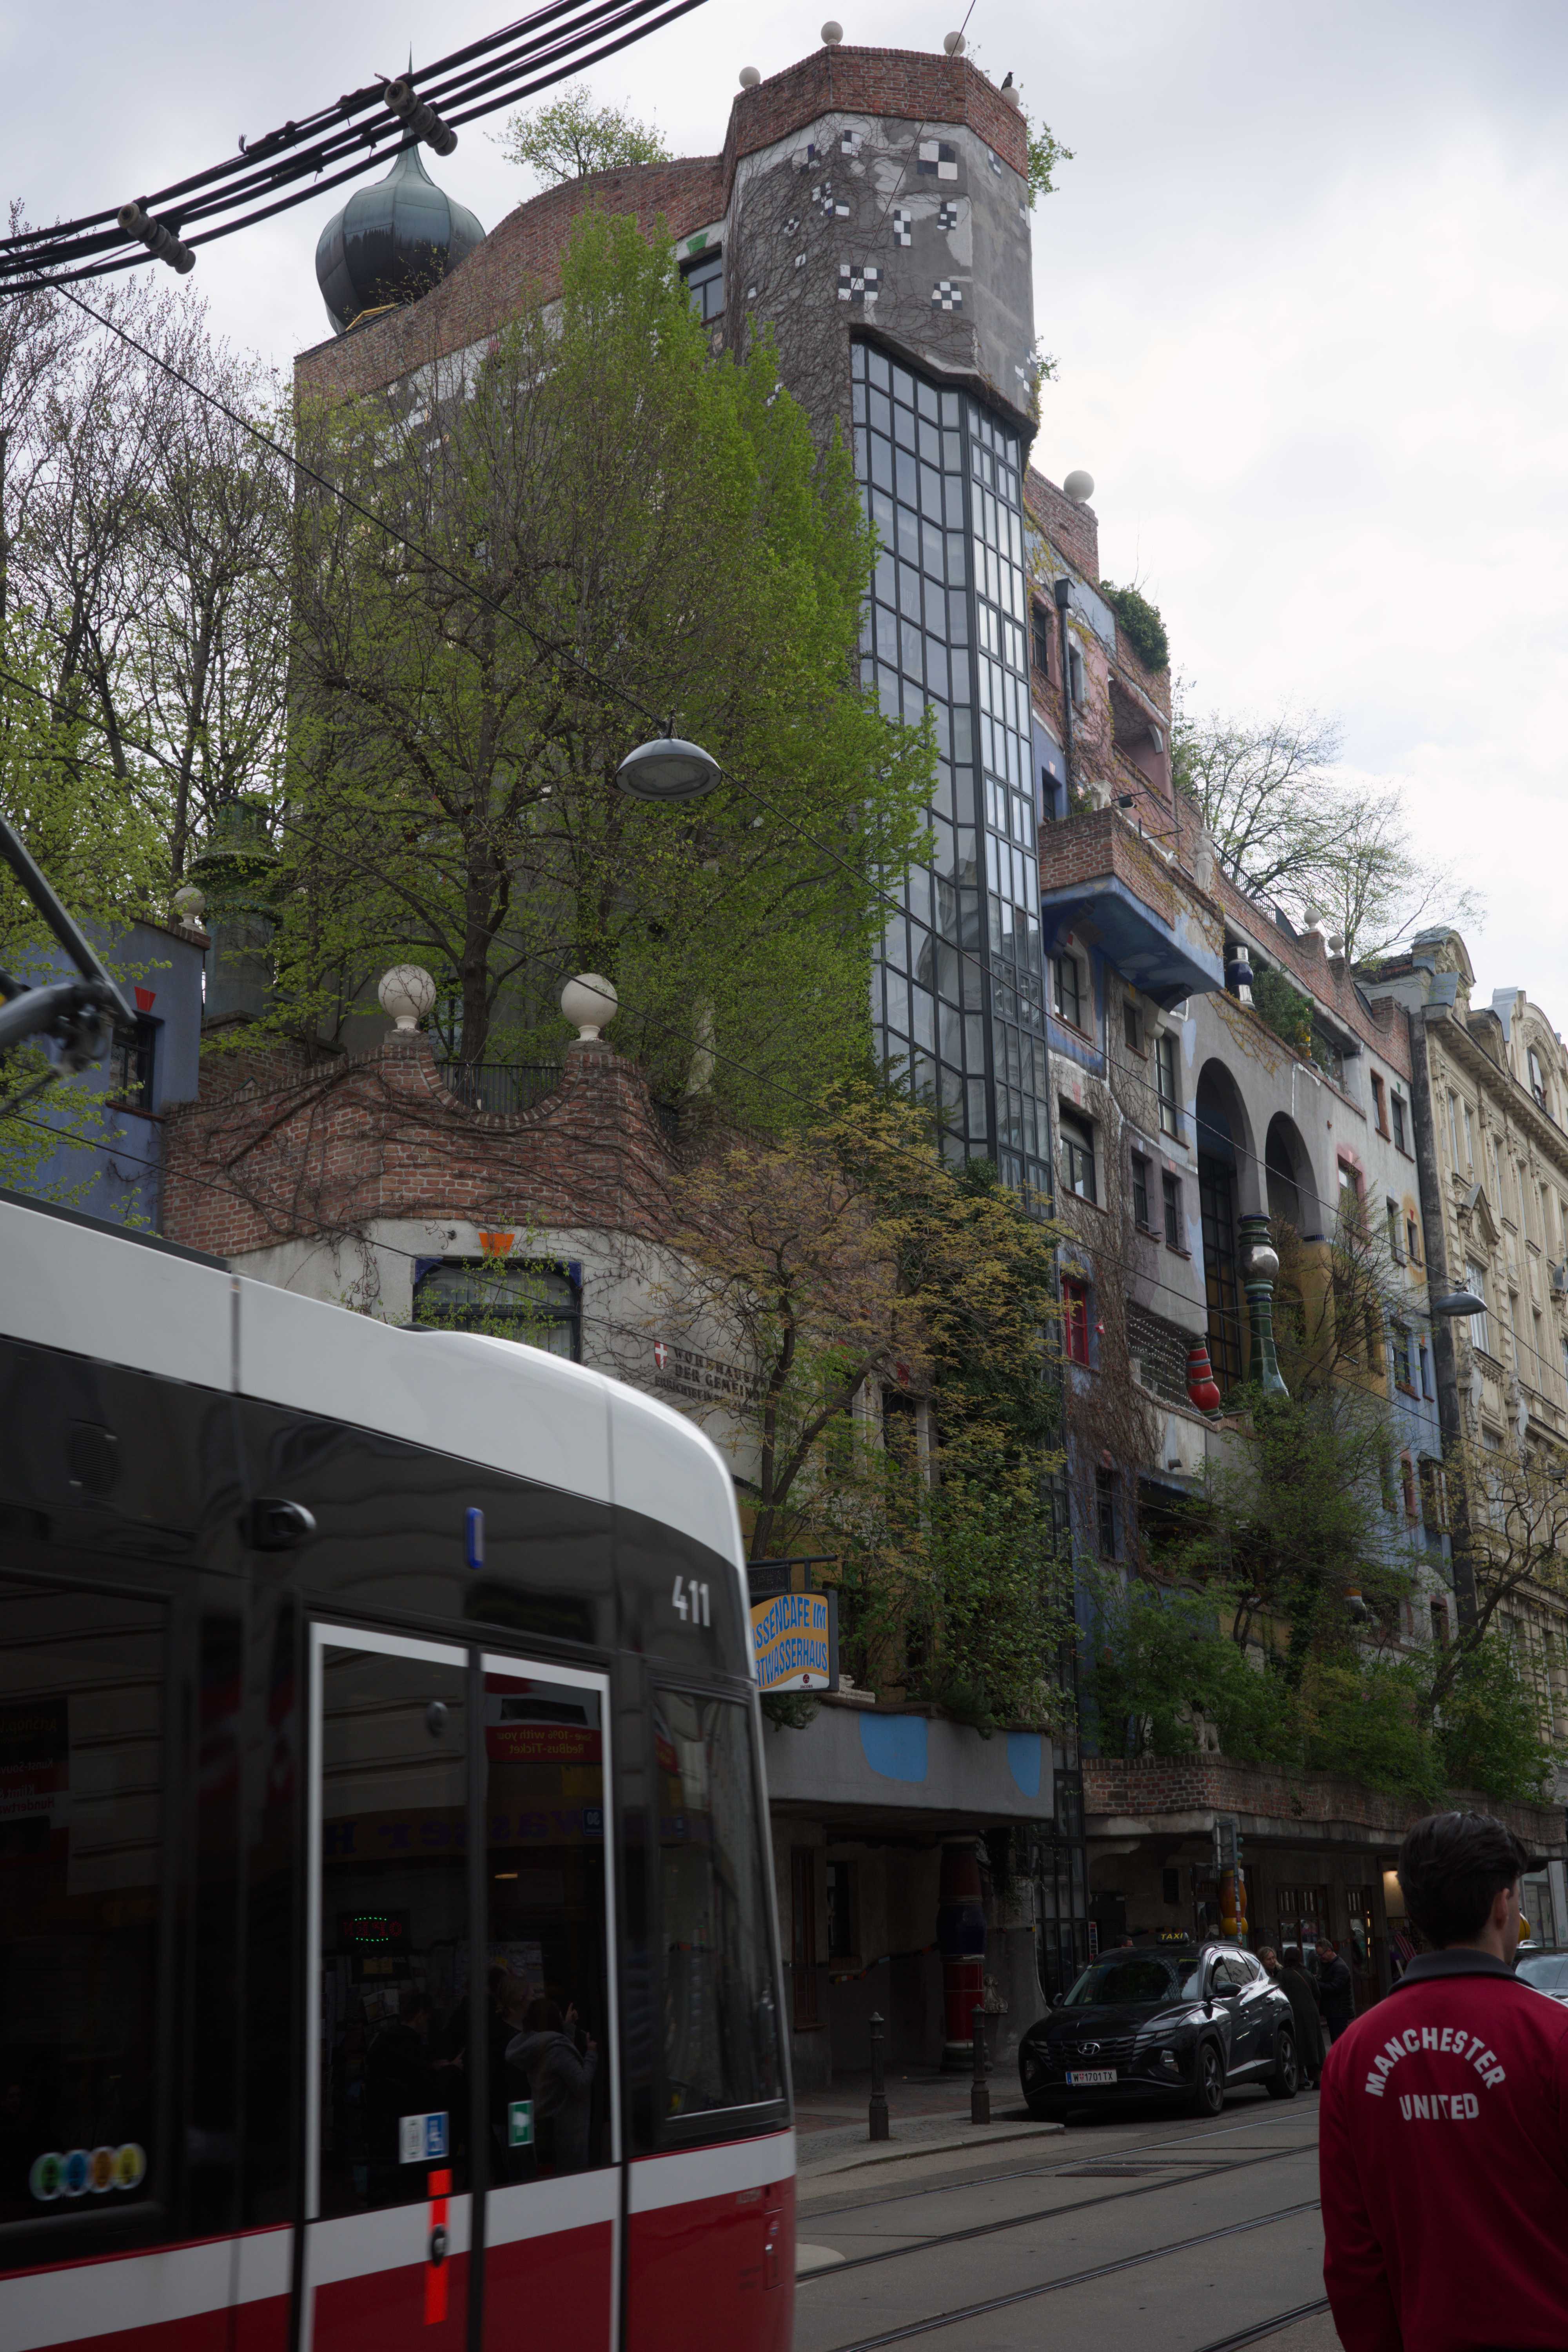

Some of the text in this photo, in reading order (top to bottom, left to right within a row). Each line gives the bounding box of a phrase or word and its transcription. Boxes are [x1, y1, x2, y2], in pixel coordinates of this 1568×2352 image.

[675, 1363, 700, 1383] DER
[672, 1575, 710, 1627] 411
[813, 1602, 827, 1630] IM
[1364, 2026, 1506, 2098] MANCHESTER
[1399, 2092, 1480, 2121] UNITED
